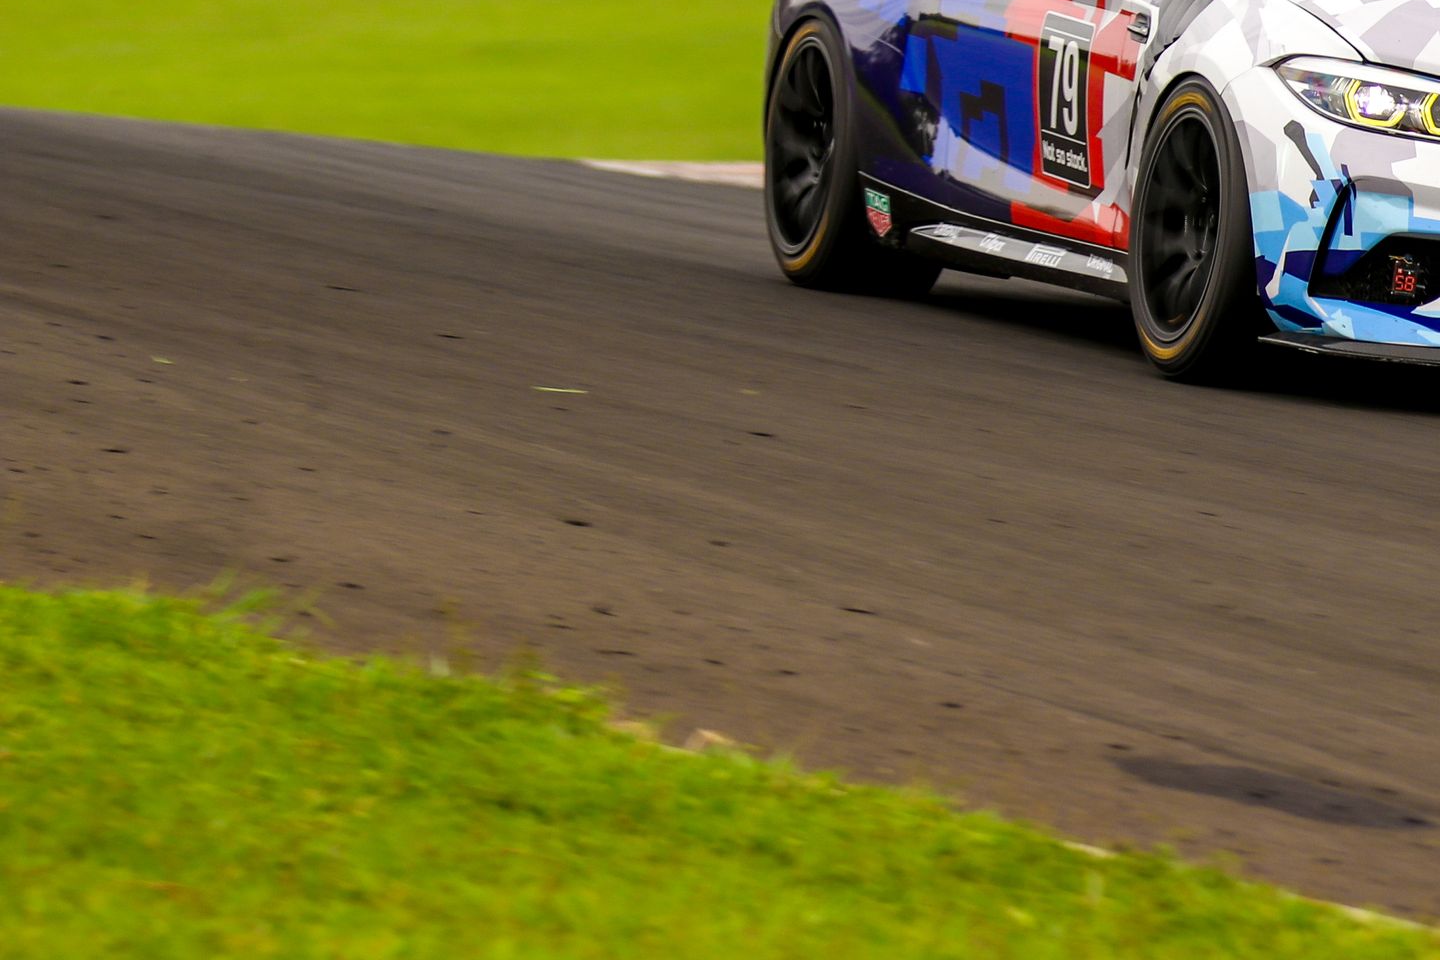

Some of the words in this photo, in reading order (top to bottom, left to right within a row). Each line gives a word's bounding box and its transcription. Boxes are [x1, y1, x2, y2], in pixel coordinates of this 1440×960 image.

[1048, 34, 1080, 136] 79
[1042, 139, 1056, 162] Not
[1055, 148, 1066, 165] so
[866, 191, 889, 212] TAG
[1025, 243, 1067, 268] PIRELLI
[1394, 275, 1415, 292] 58
